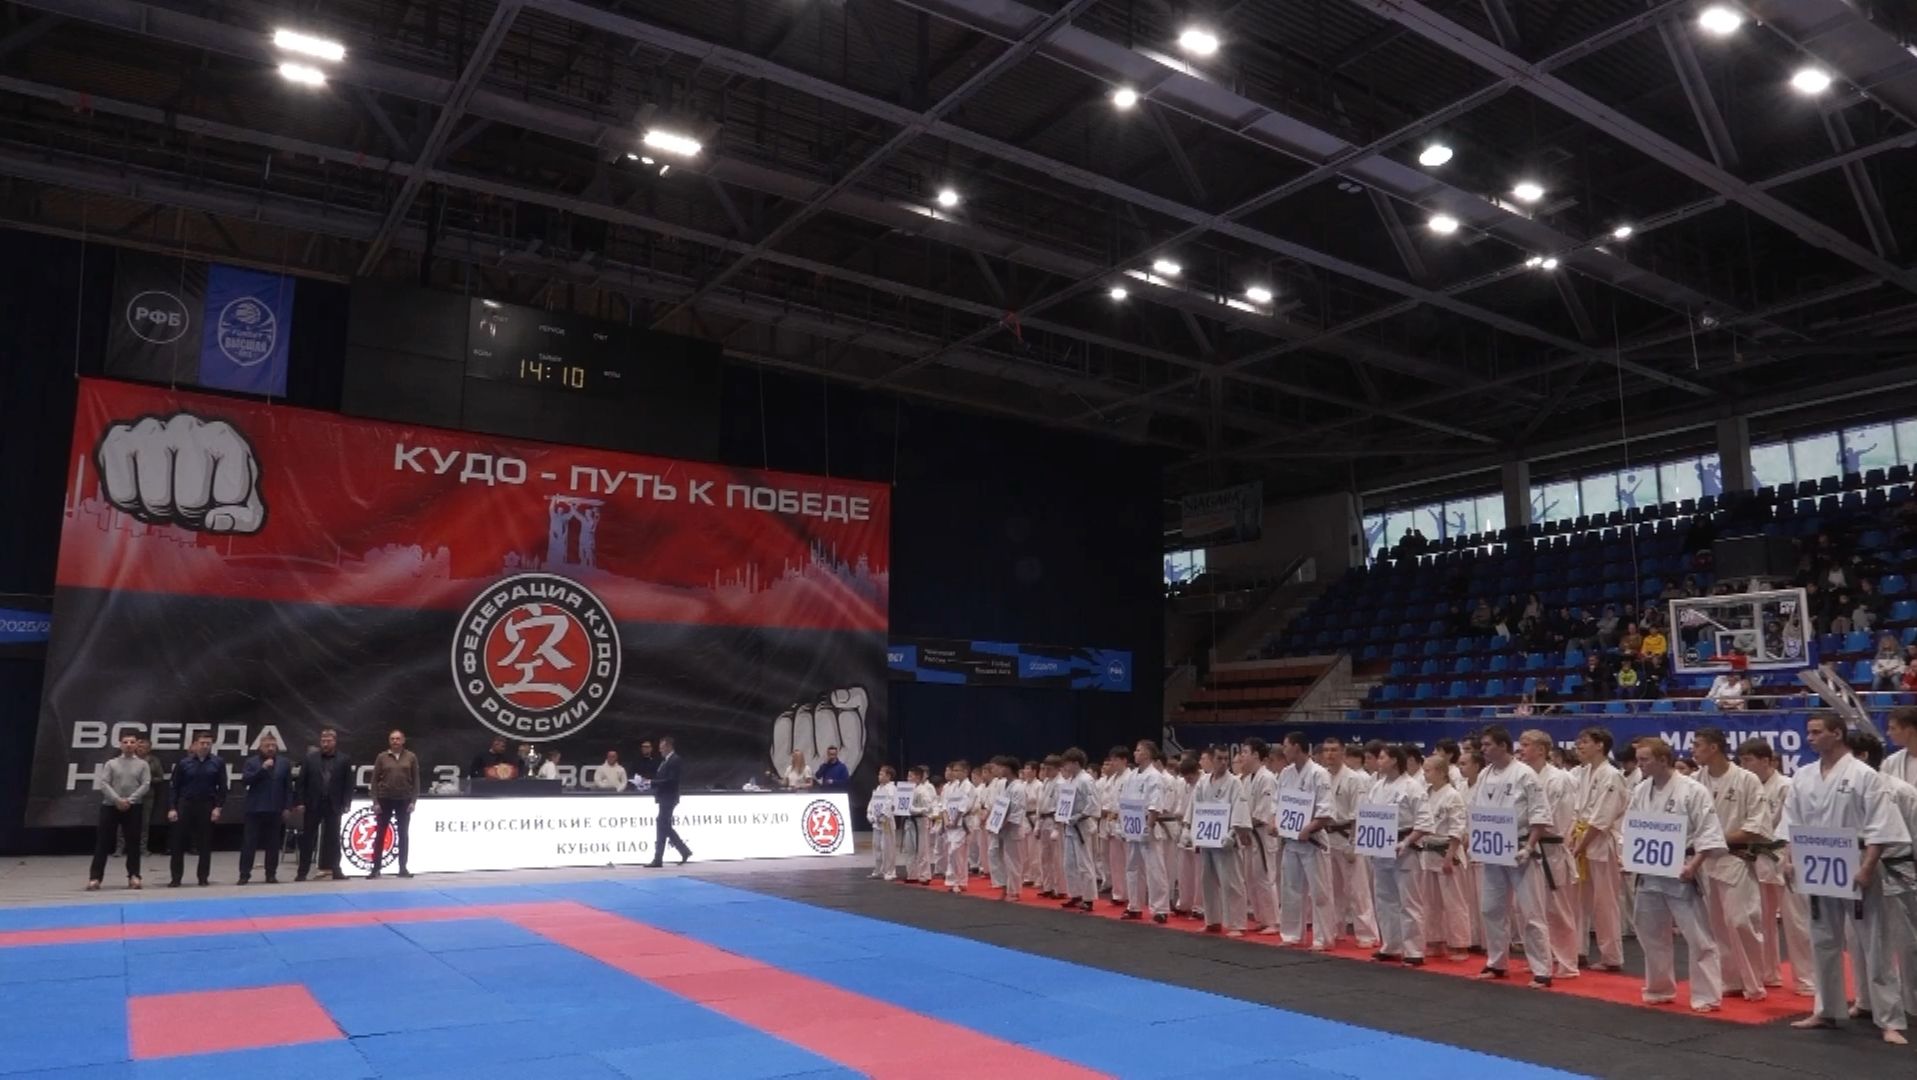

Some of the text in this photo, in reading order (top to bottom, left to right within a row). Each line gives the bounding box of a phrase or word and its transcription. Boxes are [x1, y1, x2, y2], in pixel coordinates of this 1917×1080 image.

[135, 307, 182, 327] РФБ
[520, 358, 585, 389] 14:10
[393, 443, 527, 487] КУДО
[569, 465, 677, 500] ПУТЬ
[688, 479, 715, 506] К
[725, 484, 870, 524] ПОБЕДЕ
[463, 582, 612, 678] ФЕДЕРАЦИЯ КУДО
[481, 696, 590, 732] РОССИИ
[71, 720, 288, 756] ВСЕГДА
[1660, 730, 1802, 751] МАНИТО
[434, 812, 790, 832] ВСЕРОССИЙСКИЕ СОРЕВНВАНИЯ ПО КУДО
[1123, 815, 1142, 834] 230
[1196, 821, 1222, 840] 240
[1280, 809, 1305, 832] 250
[1628, 818, 1682, 833] КОЭФФИЦИЕНТ
[556, 841, 611, 855] КУБОК
[616, 841, 648, 852] ПАО
[1356, 825, 1395, 849] 200+
[1471, 829, 1515, 856] 250+
[1793, 834, 1853, 849] КОЭФФИЦИЕНТ
[1632, 837, 1674, 867] 260
[1804, 854, 1848, 888] 270
